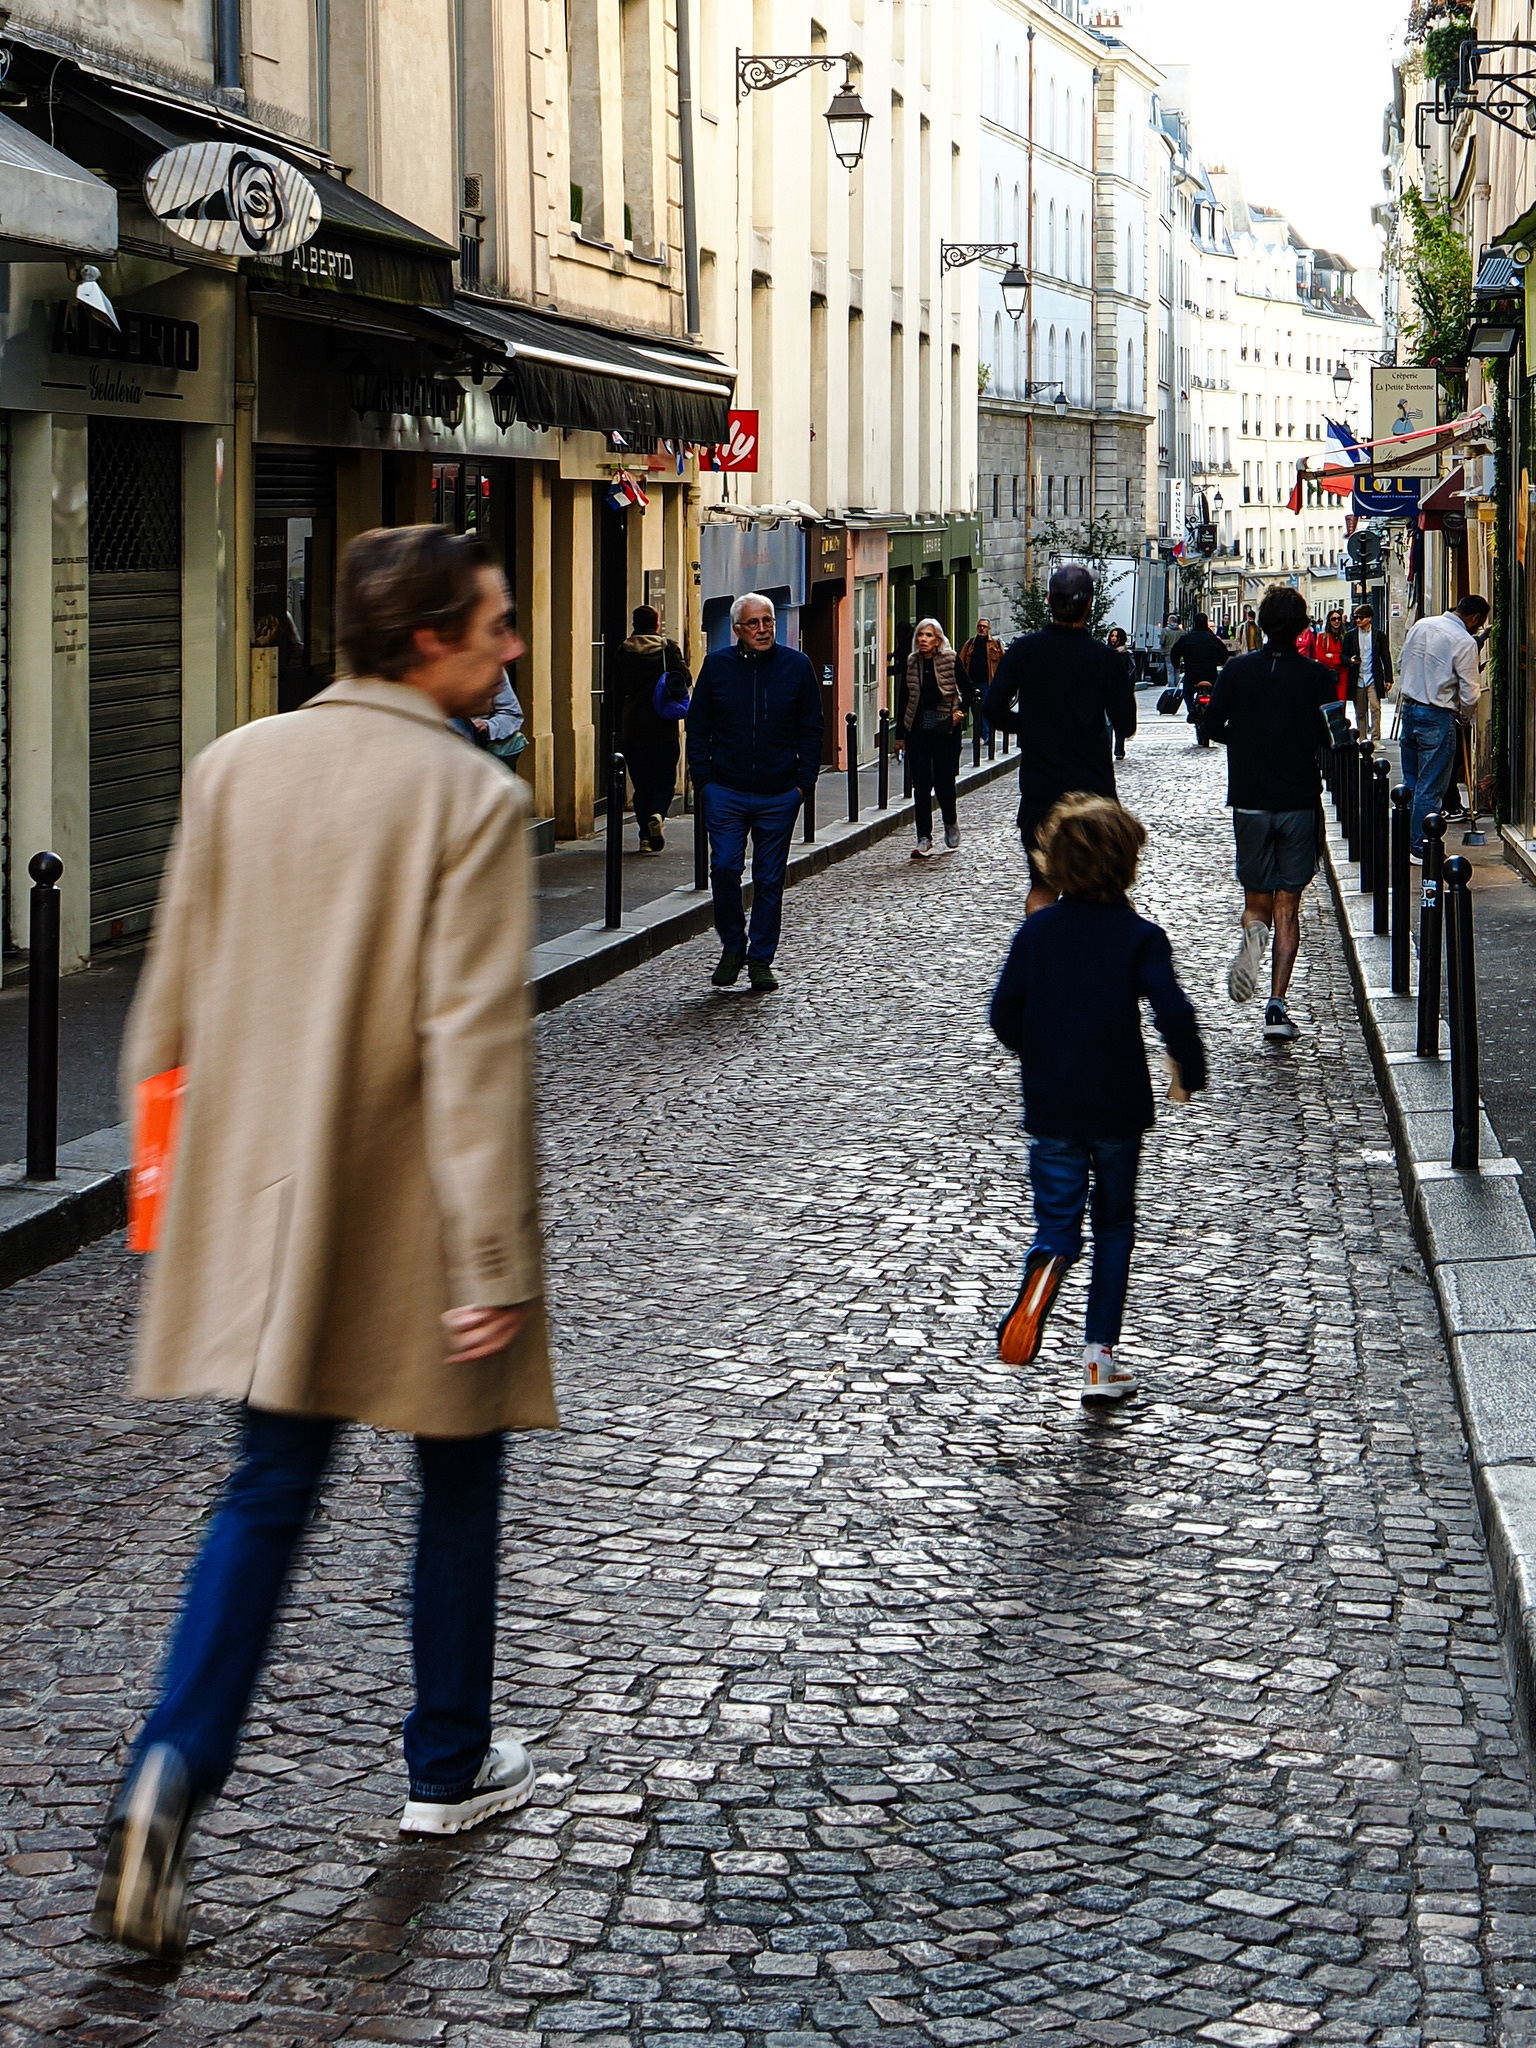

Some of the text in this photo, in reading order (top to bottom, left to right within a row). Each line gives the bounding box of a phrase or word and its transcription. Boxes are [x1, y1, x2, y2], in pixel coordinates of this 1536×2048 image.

[292, 244, 354, 280] ALBERTO
[89, 364, 142, 404] Gelateria
[1392, 372, 1418, 380] Crêperie
[1375, 383, 1434, 392] La Petite Bretonne
[1360, 477, 1413, 493] LCL
